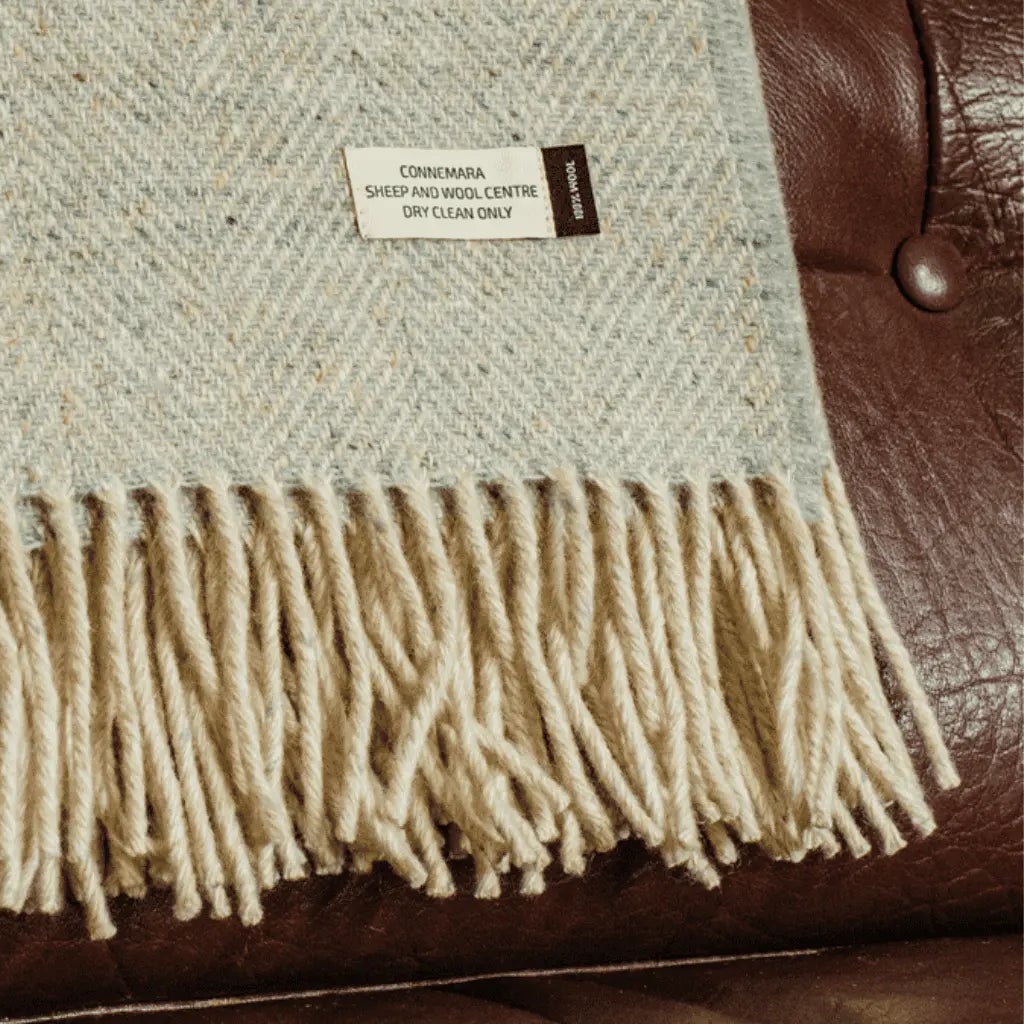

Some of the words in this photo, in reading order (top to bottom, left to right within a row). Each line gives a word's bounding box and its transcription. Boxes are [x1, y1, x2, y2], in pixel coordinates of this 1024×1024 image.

[400, 165, 486, 180] CONNEMARA
[565, 159, 579, 193] WOOL
[365, 185, 409, 199] SHEEP
[412, 186, 439, 199] AND
[441, 186, 483, 200] WOOL
[484, 184, 539, 200] CENTRE
[402, 205, 429, 218] DRY
[432, 206, 474, 219] CLEAN
[477, 205, 513, 220] ONLY
